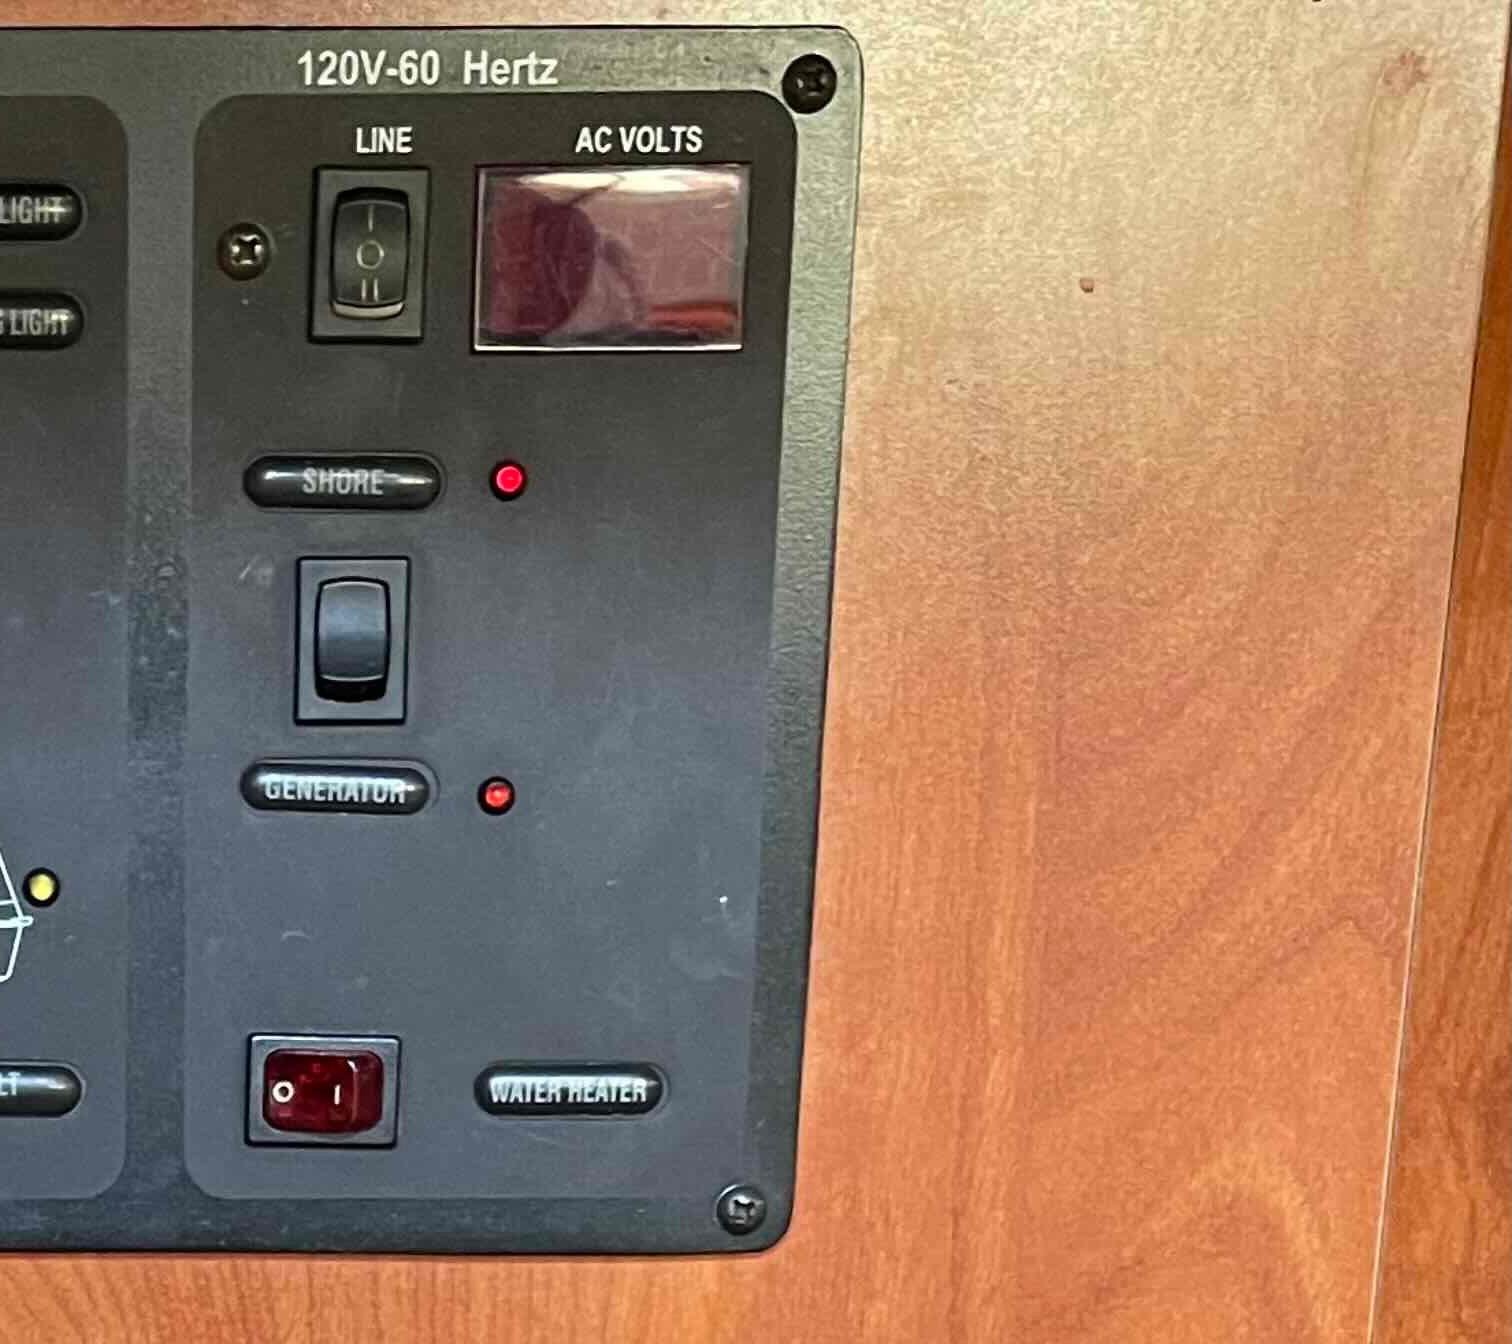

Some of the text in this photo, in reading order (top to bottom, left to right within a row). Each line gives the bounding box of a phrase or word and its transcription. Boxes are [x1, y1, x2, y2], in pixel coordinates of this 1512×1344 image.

[297, 50, 558, 85] 120V-60 Hertz
[356, 127, 412, 153] LINE
[576, 127, 702, 153] AC VOLTS
[10, 310, 69, 335] LIGHT
[302, 468, 384, 495] SHORE
[265, 778, 405, 804] GENERATOR
[490, 1079, 647, 1104] WATER HEATER
